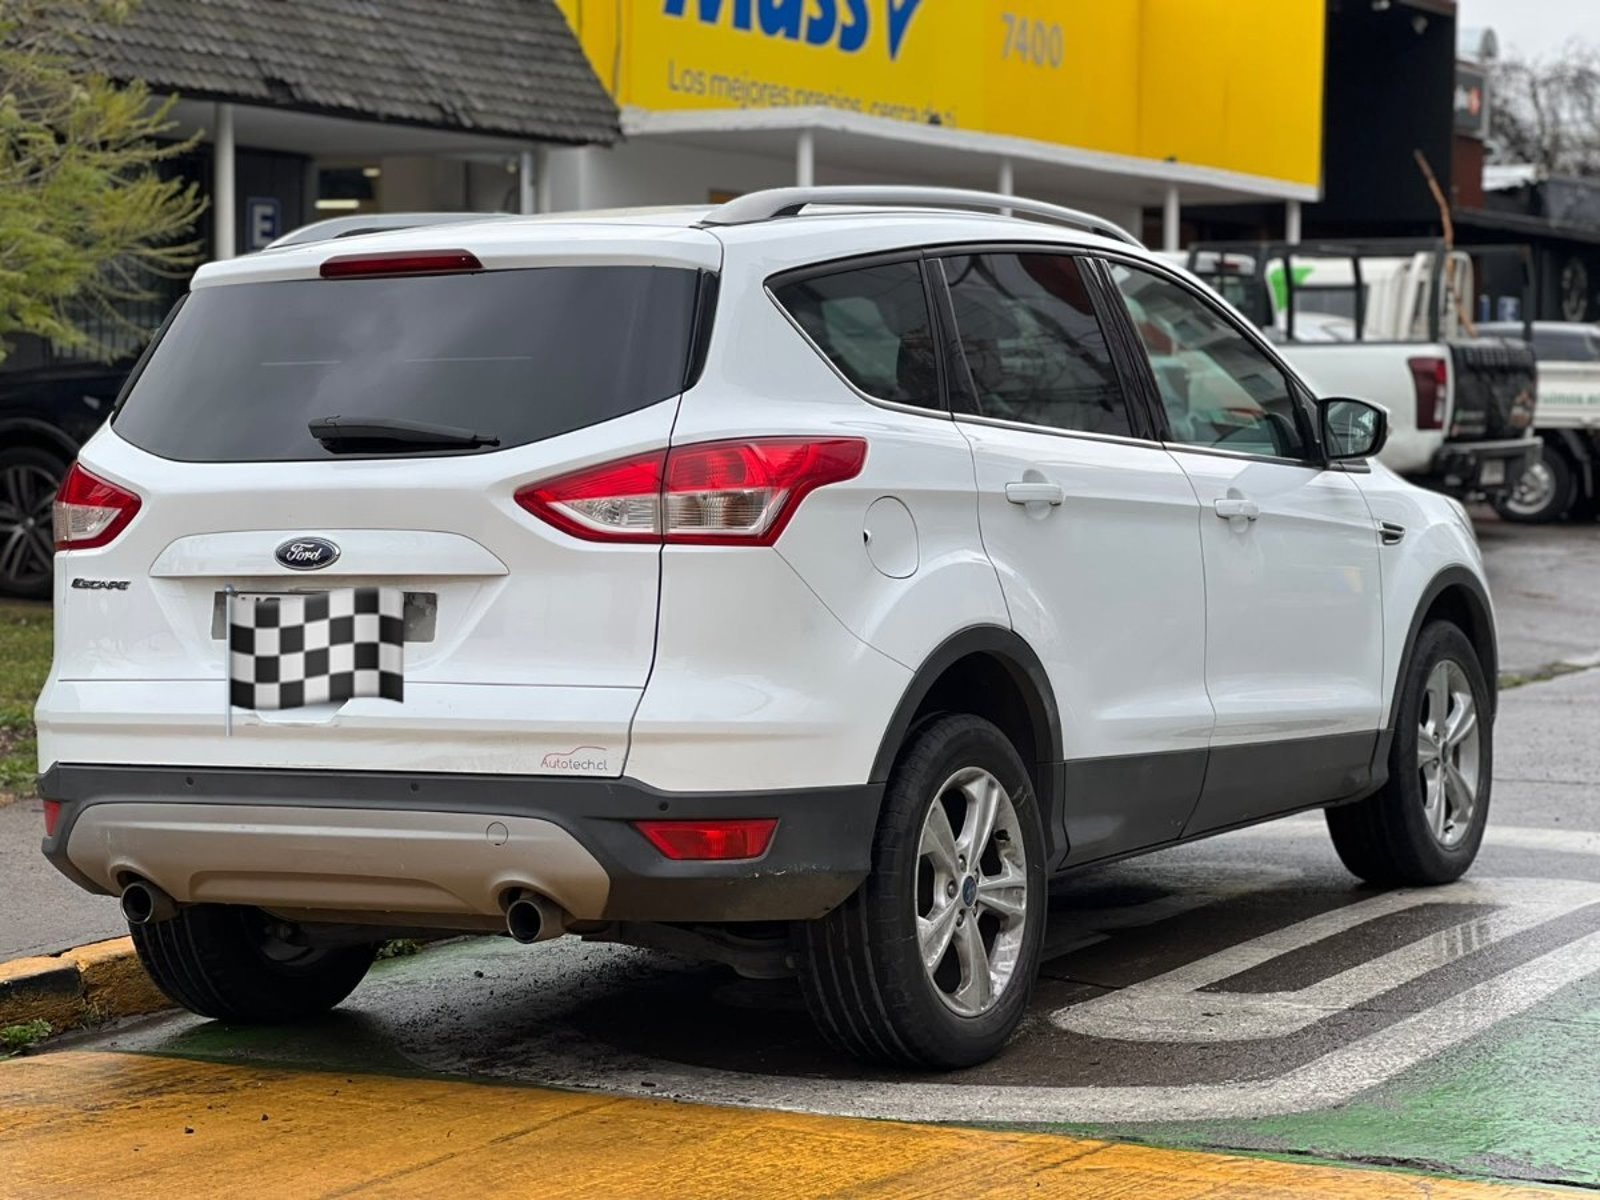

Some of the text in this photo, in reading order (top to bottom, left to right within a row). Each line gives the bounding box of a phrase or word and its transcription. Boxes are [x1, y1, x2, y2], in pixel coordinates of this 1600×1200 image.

[1001, 11, 1066, 69] 7400
[668, 59, 706, 95] Los
[709, 71, 790, 109] mejores
[253, 204, 275, 249] E
[286, 543, 322, 561] Ford
